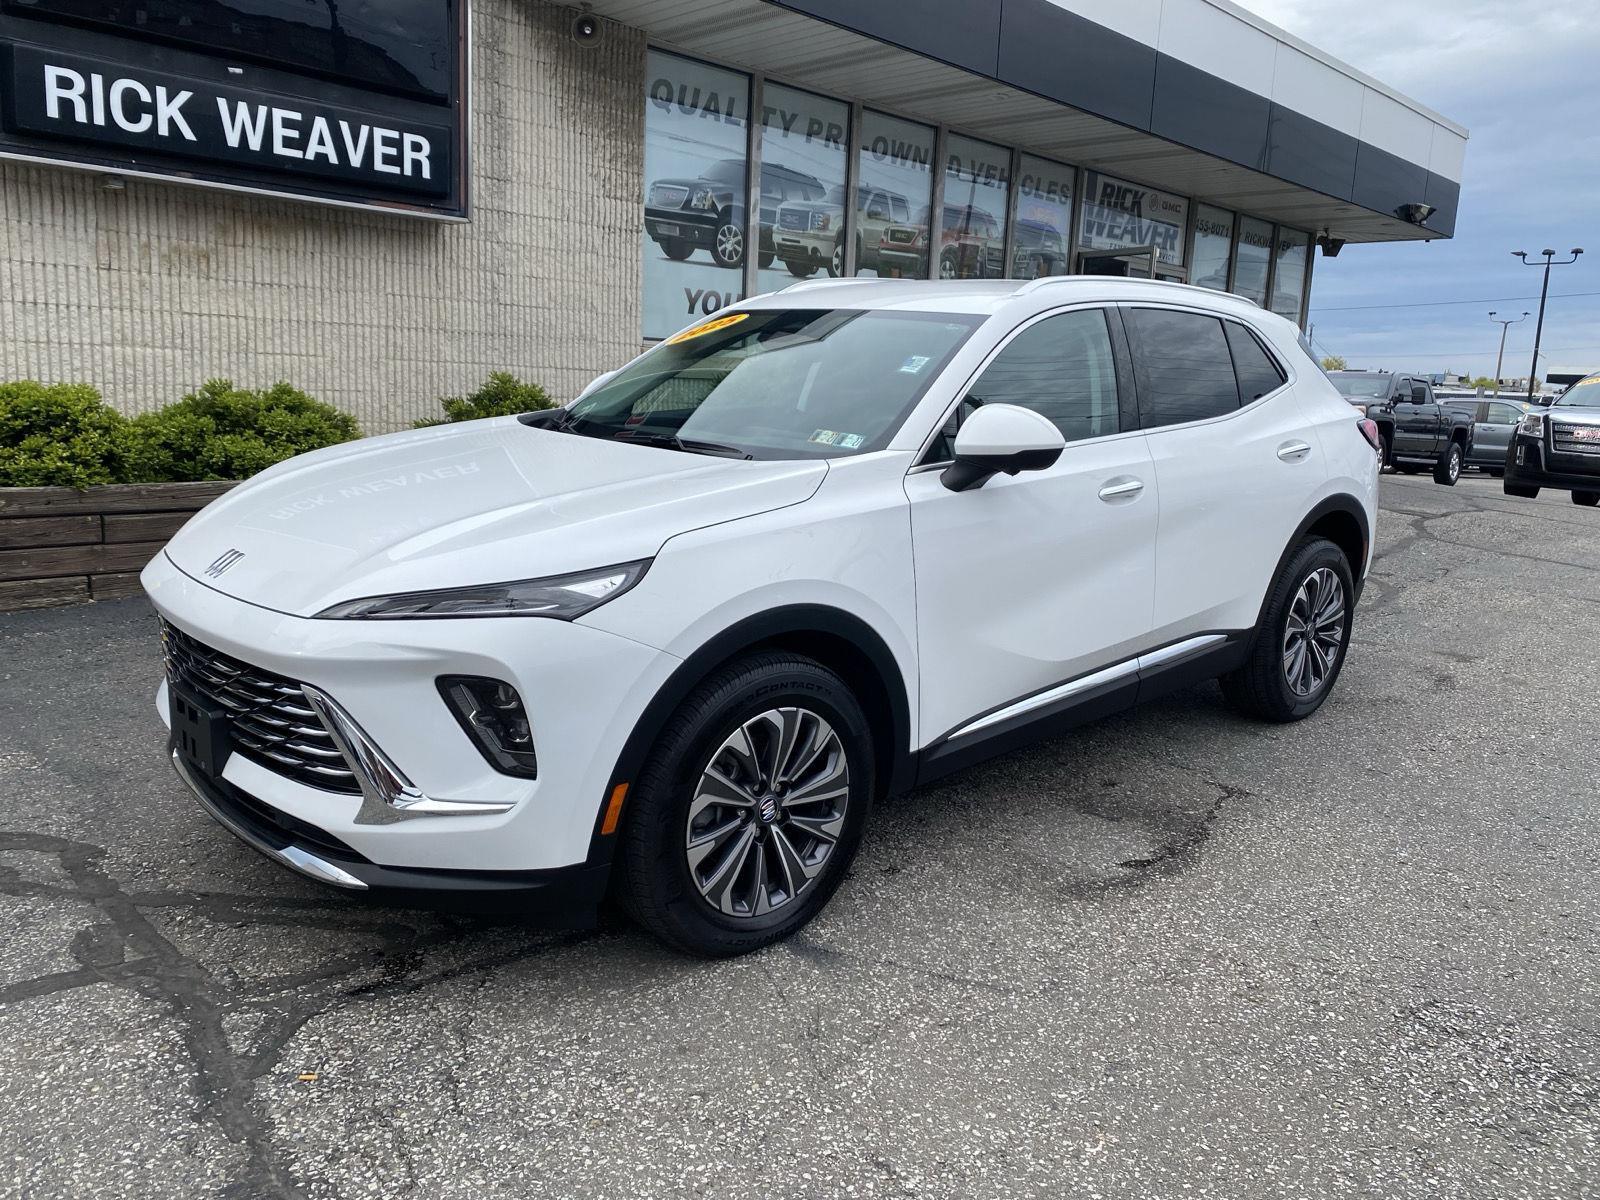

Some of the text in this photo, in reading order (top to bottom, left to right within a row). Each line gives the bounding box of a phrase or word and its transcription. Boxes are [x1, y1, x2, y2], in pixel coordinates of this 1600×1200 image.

[44, 64, 432, 180] RICK WEAVER
[650, 78, 1071, 204] QUALTY PR-OWND VEHCLES
[1098, 181, 1182, 218] RICK GMC
[1085, 205, 1179, 251] WEAVER
[1573, 430, 1600, 441] GM
